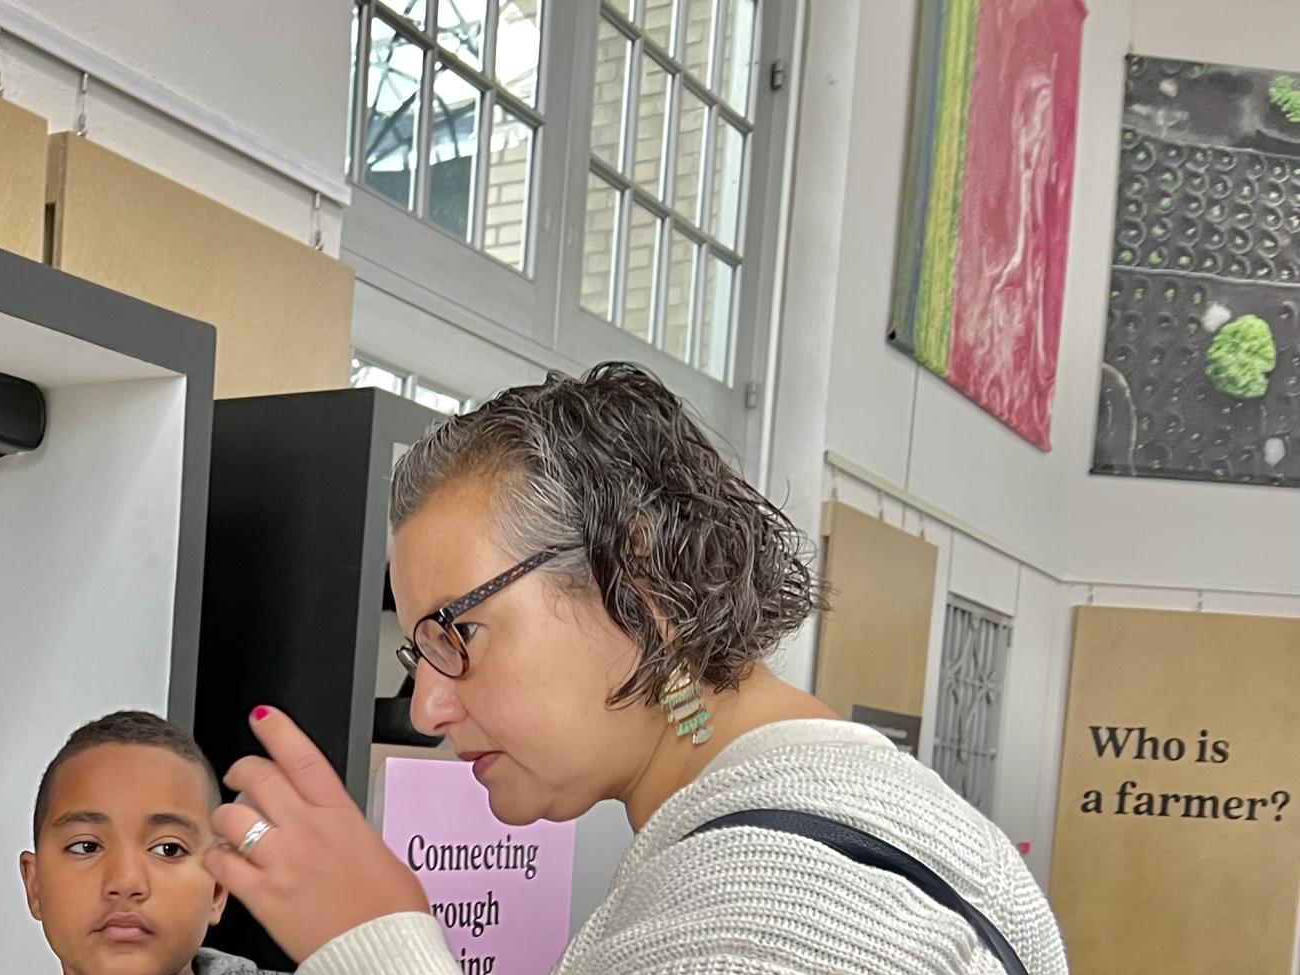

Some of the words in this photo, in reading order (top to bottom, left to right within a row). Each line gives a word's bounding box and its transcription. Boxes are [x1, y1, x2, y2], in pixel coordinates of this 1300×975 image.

[1089, 726, 1186, 761] Who
[1195, 729, 1230, 763] is
[1080, 789, 1103, 814] a
[1114, 780, 1291, 822] farmer?
[407, 834, 539, 880] Connecting
[431, 890, 499, 937] rough
